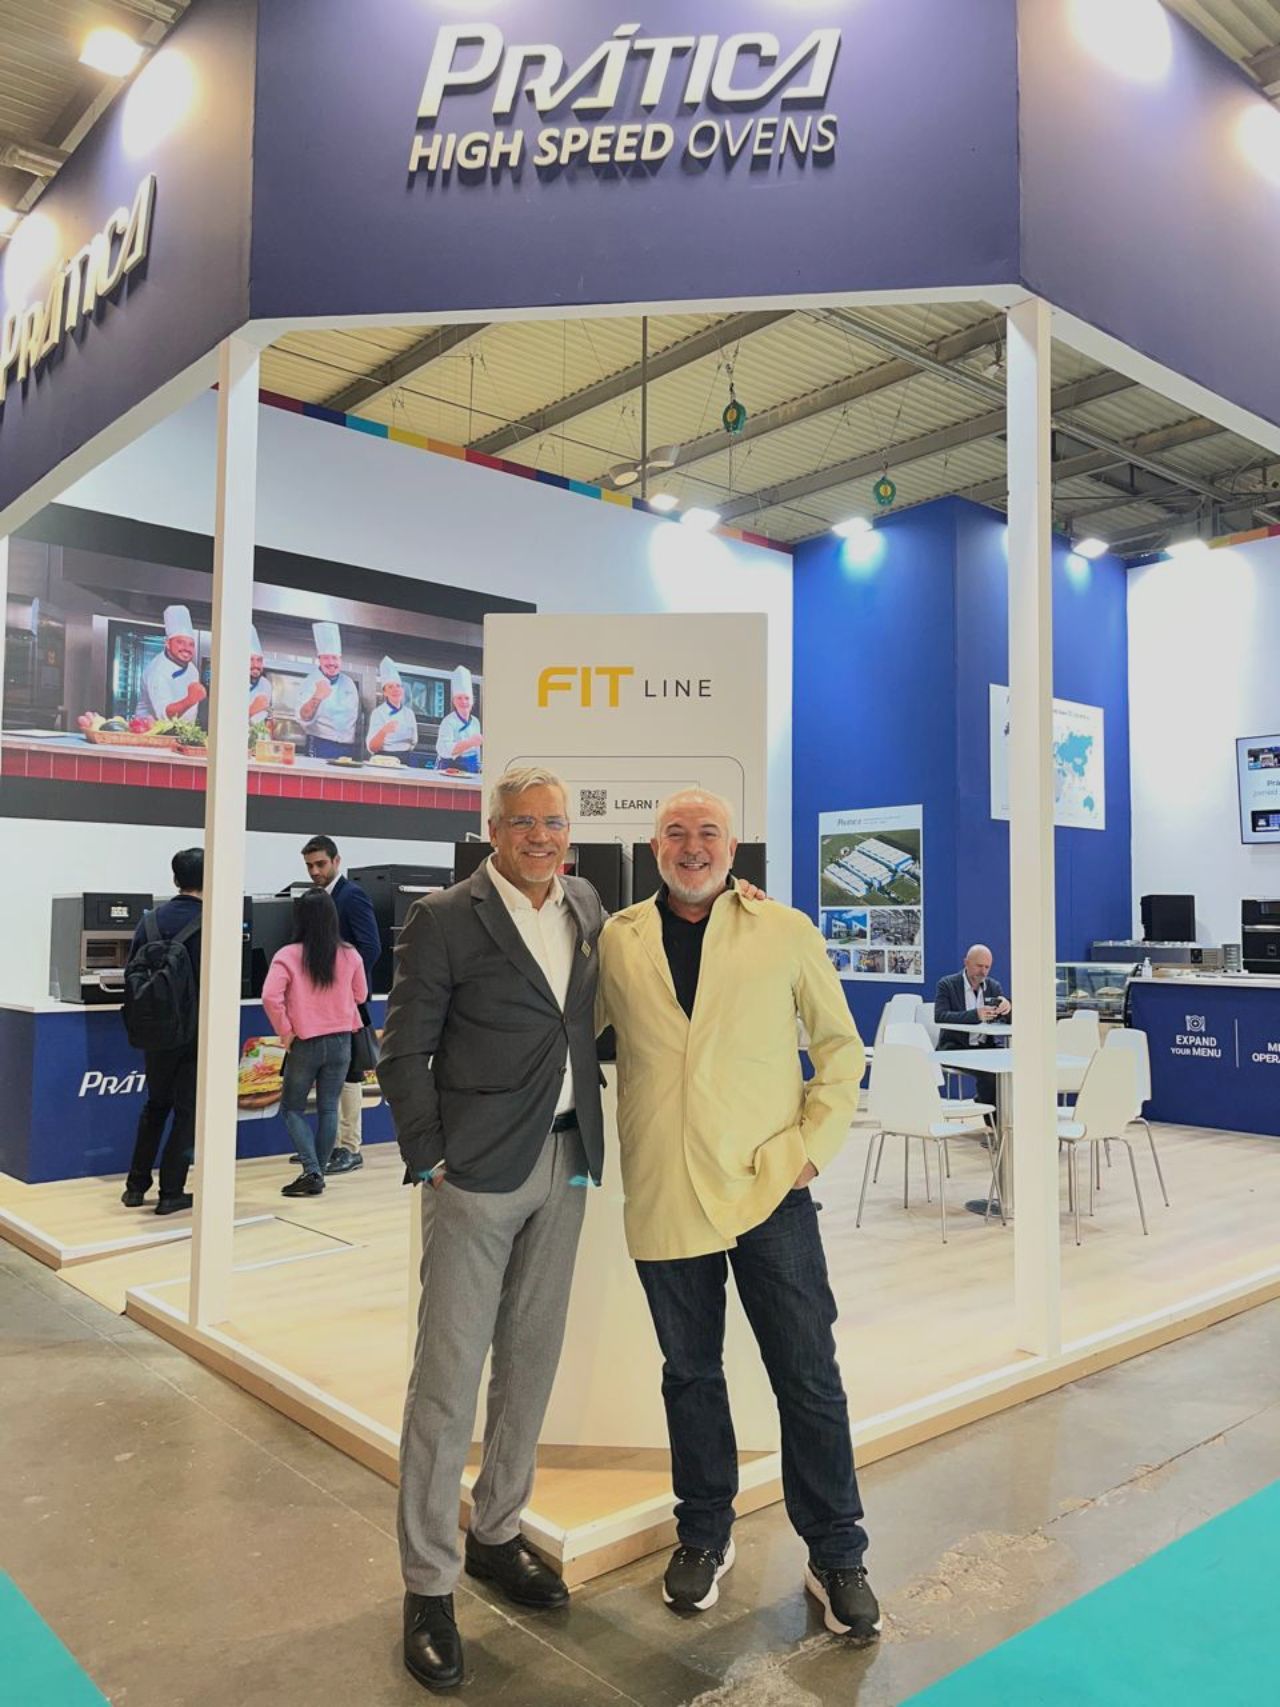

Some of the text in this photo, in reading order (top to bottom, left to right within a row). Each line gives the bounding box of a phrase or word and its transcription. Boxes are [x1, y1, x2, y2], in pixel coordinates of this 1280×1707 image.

[417, 23, 841, 117] PRÁTICA
[408, 114, 837, 172] HIGH SPEED OVENS
[538, 666, 712, 708] FIT LINE
[614, 799, 653, 809] LEARN
[1170, 1047, 1222, 1058] YOUR MENU
[1175, 1034, 1217, 1047] EXPAND
